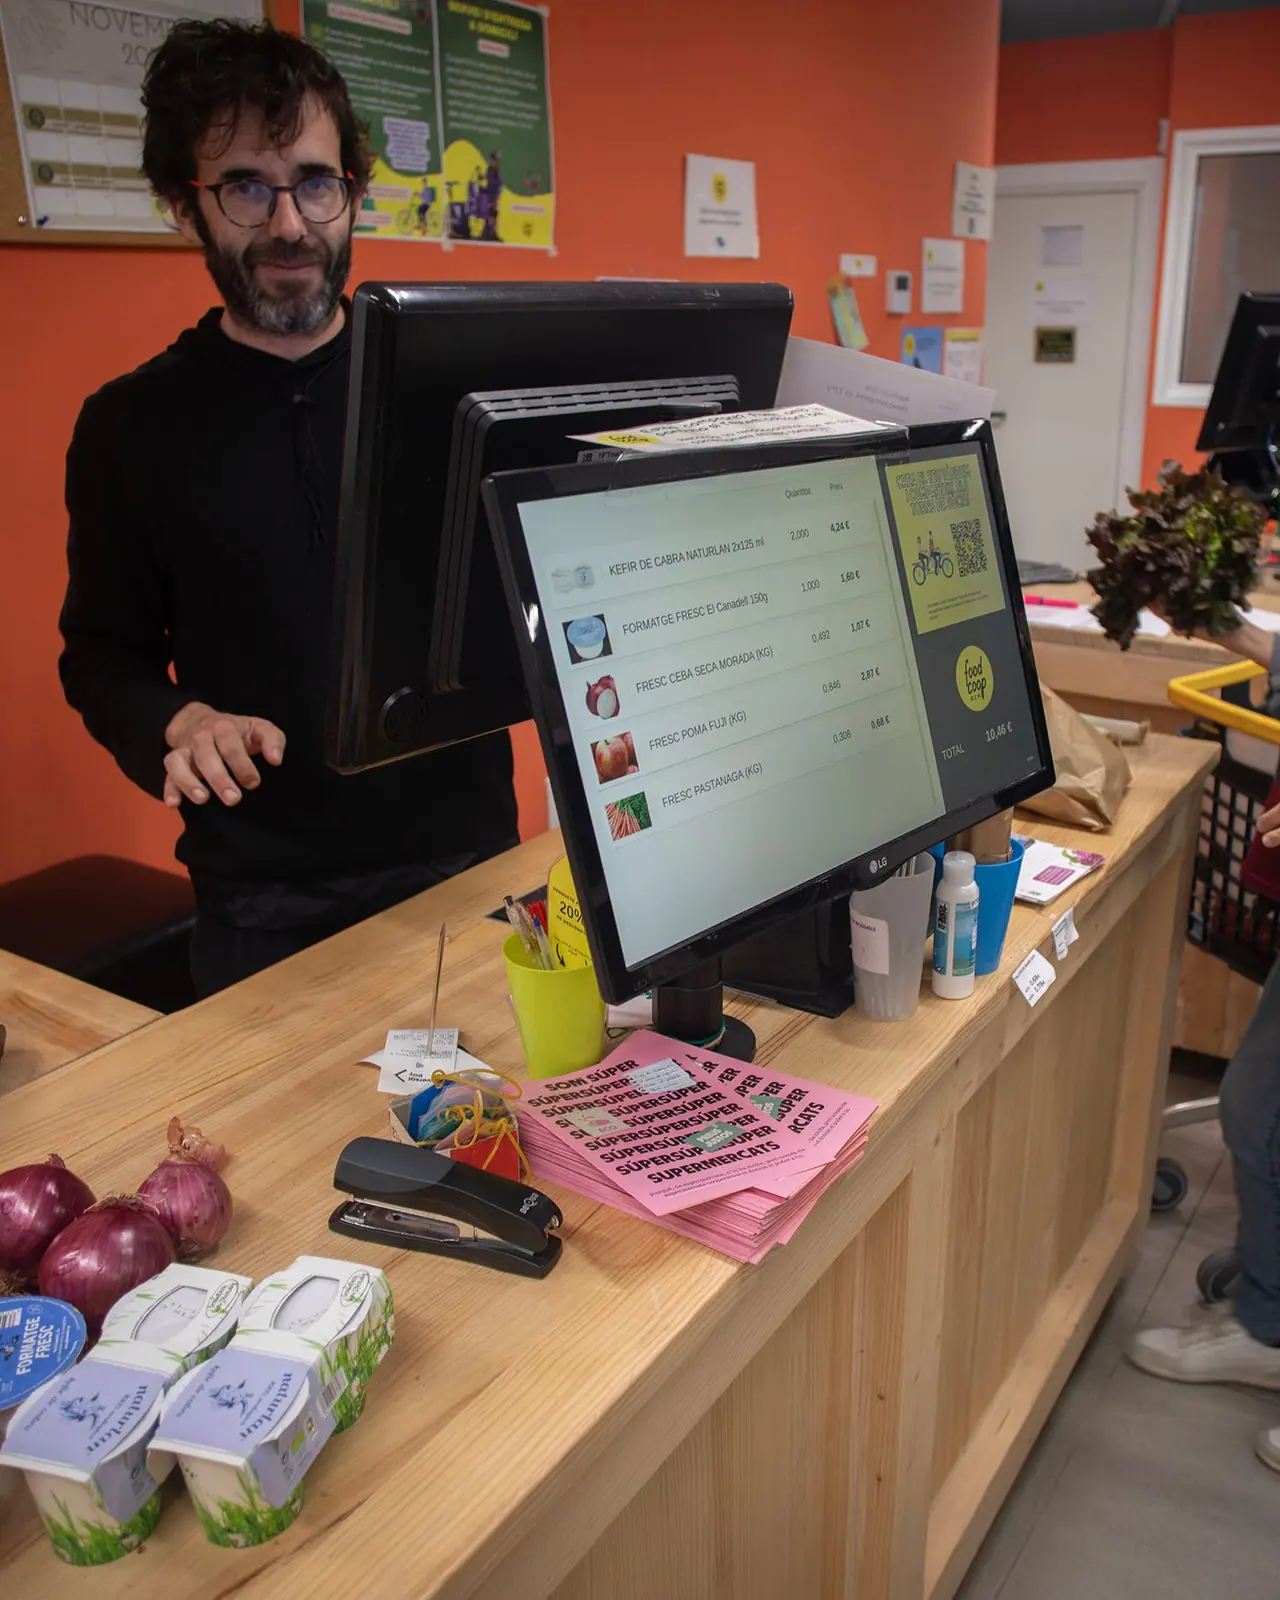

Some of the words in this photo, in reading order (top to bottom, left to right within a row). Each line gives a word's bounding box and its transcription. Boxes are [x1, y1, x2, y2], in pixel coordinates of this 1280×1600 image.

[70, 3, 166, 38] NOVEM
[830, 522, 844, 534] 4,24
[608, 561, 638, 576] KEFIR
[640, 558, 652, 571] DE
[654, 552, 686, 568] CABRA
[686, 543, 731, 561] NATURLAN
[732, 538, 755, 554] 2x125
[755, 537, 764, 548] ml
[840, 572, 854, 584] 1,60
[622, 616, 674, 636] FORMATGE
[676, 606, 706, 622] FRESC
[716, 596, 748, 612] Canadell
[750, 593, 769, 606] 150g
[812, 630, 831, 643] 0,492
[851, 620, 864, 632] 1,07
[636, 676, 668, 694] FRESC
[670, 669, 694, 684] CEBA
[695, 662, 718, 676] SECA
[719, 652, 756, 670] MORADA
[756, 646, 774, 662] (KG)
[860, 668, 874, 682] 2,87
[964, 656, 983, 682] food
[967, 677, 987, 700] coop
[649, 732, 680, 750] FRESC
[682, 724, 708, 740] POMA
[709, 717, 728, 731] FUJI
[729, 710, 747, 727] (KG)
[942, 744, 965, 760] TOTAL
[986, 723, 1006, 742] 10,46
[662, 789, 693, 808] FRESC
[694, 770, 744, 795] PASTANAGA
[745, 762, 762, 779] (KG)
[877, 857, 888, 868] LG
[545, 1077, 588, 1092] SOM
[586, 1060, 640, 1082] SÚPER
[584, 1102, 743, 1151] SÚPERSÚPERSÚPER
[788, 1102, 825, 1134] RCATS
[647, 1141, 780, 1184] SUPERMERCATS
[16, 1316, 41, 1376] FORMATGE
[36, 1324, 55, 1360] FRESC
